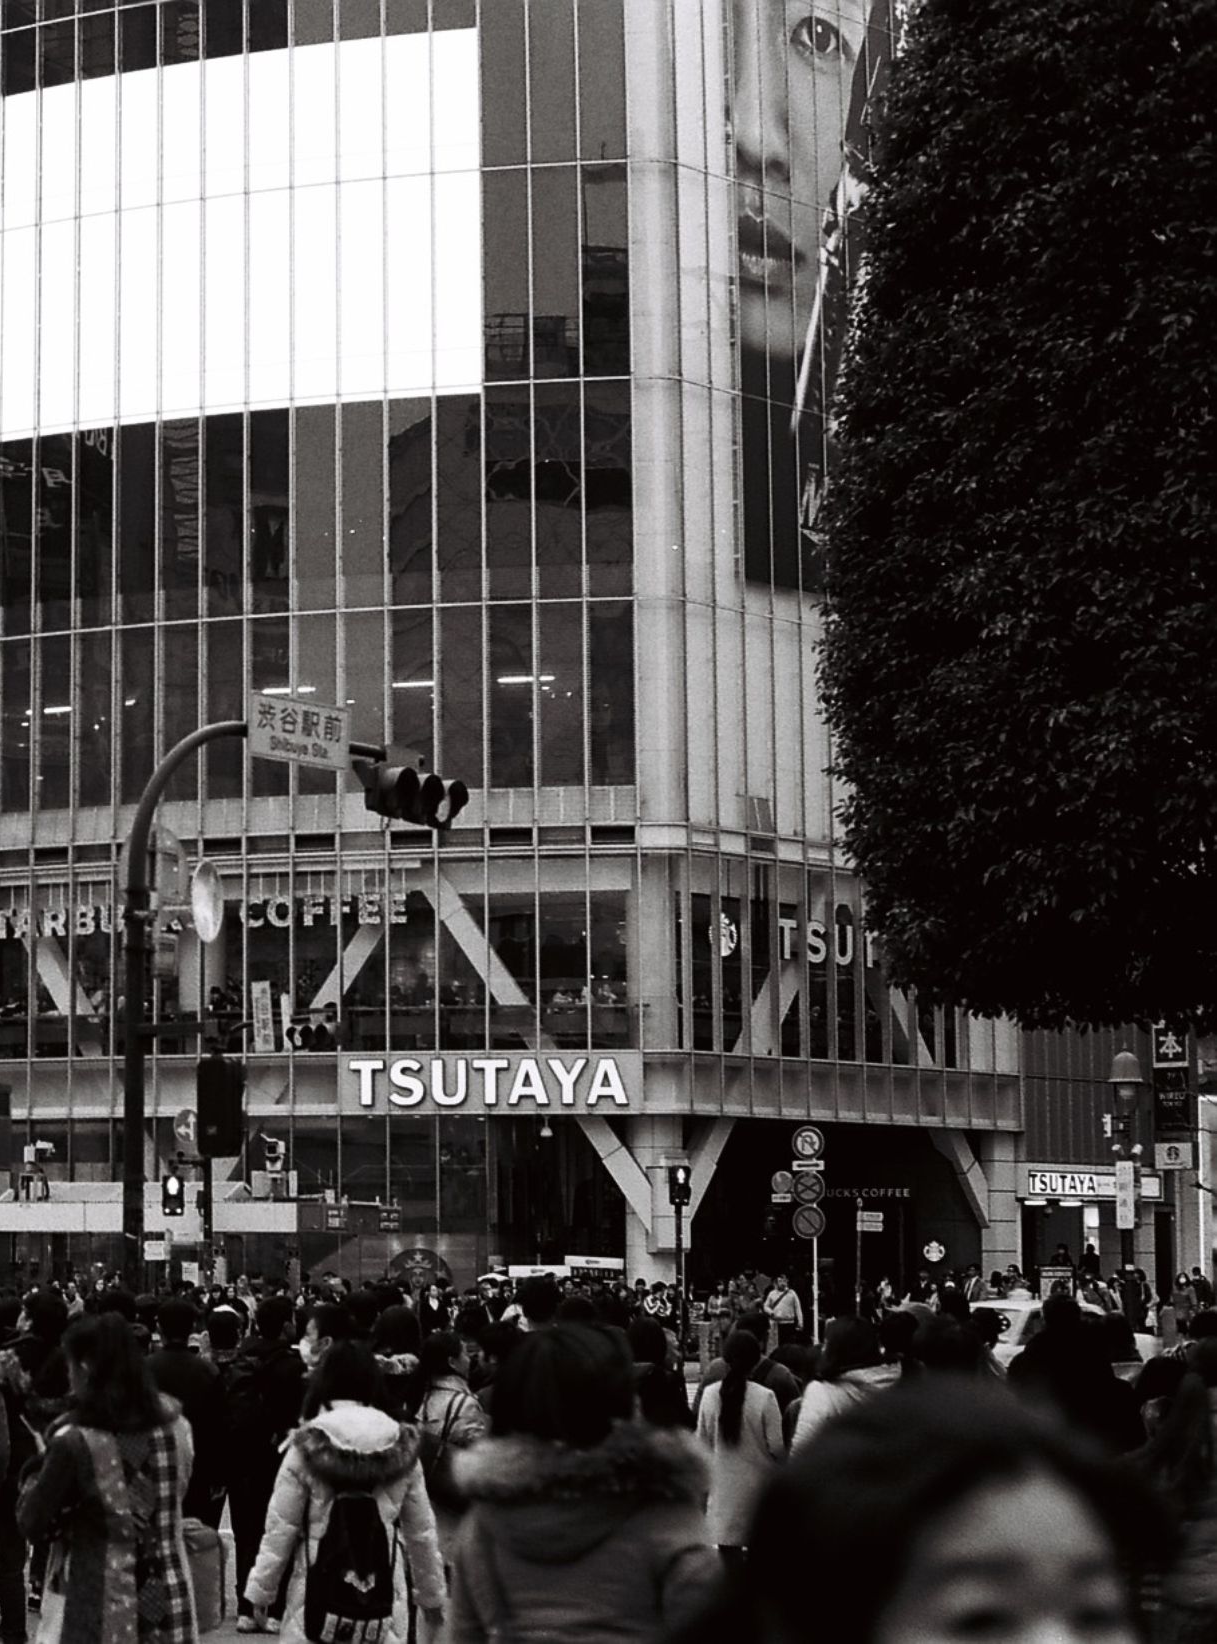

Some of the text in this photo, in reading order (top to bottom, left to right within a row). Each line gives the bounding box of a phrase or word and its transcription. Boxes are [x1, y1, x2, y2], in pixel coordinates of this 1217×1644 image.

[257, 701, 342, 743] 渋谷駅前
[270, 735, 309, 757] Shibuya
[239, 892, 408, 927] COFFEE
[349, 1057, 629, 1107] TSUTAYA
[862, 1188, 911, 1198] COFFEE
[1029, 1173, 1096, 1194] TSUTAYA
